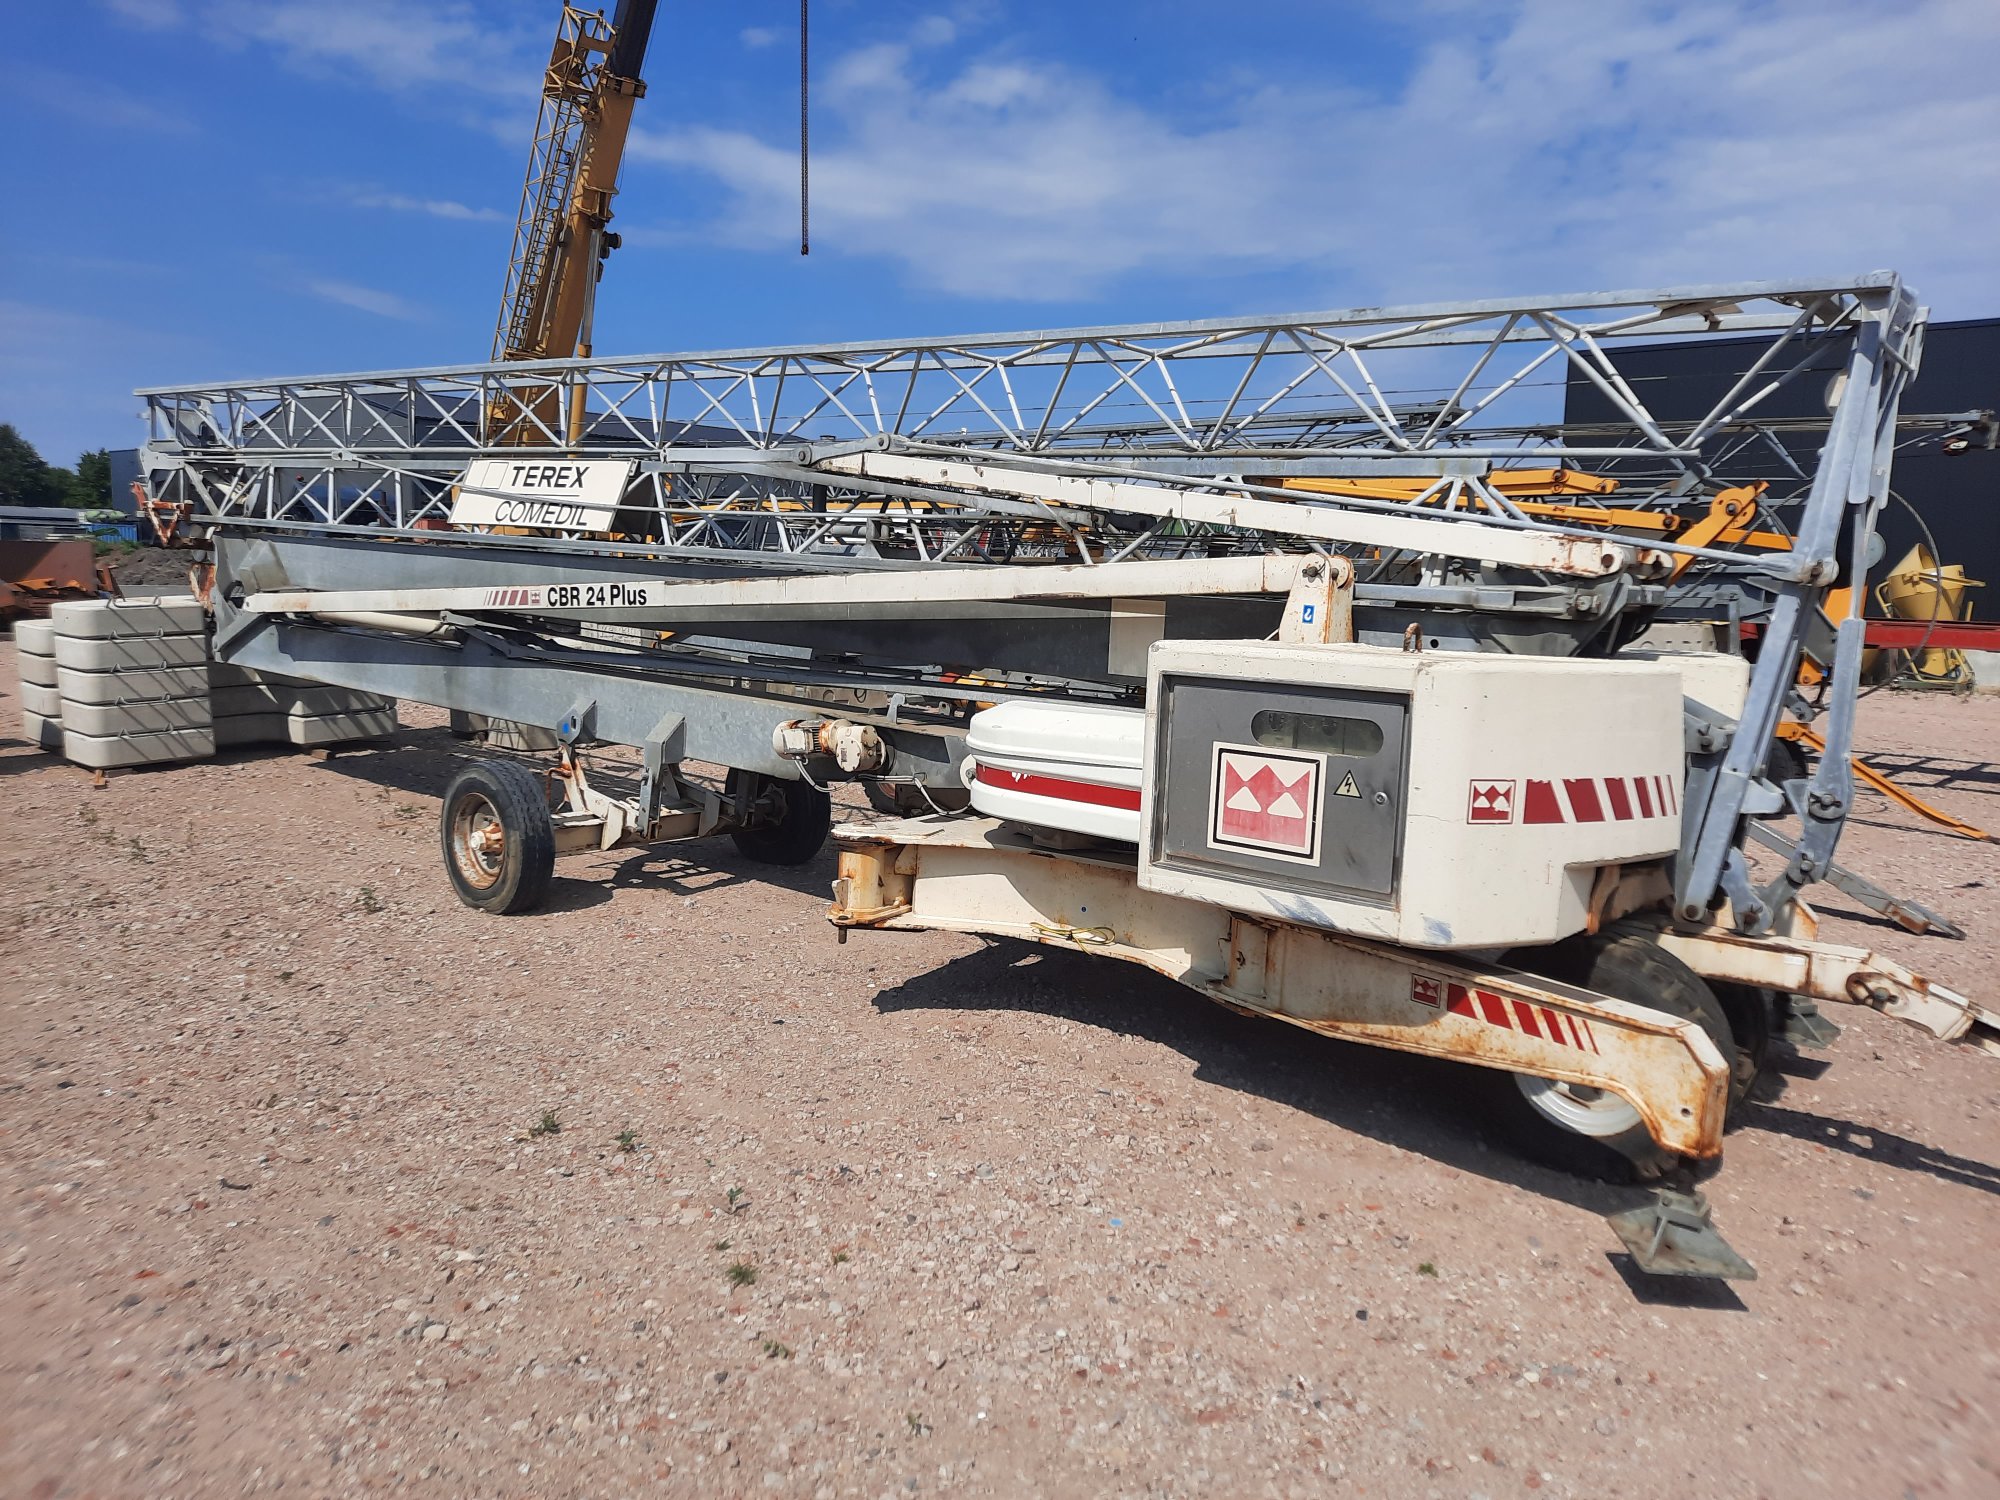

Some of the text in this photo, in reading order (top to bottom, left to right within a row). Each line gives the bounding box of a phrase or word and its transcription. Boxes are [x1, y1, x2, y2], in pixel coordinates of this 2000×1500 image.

[511, 466, 590, 488] TEREX
[495, 500, 587, 526] COMEDIL
[547, 584, 647, 607] CBR 24 Plus
